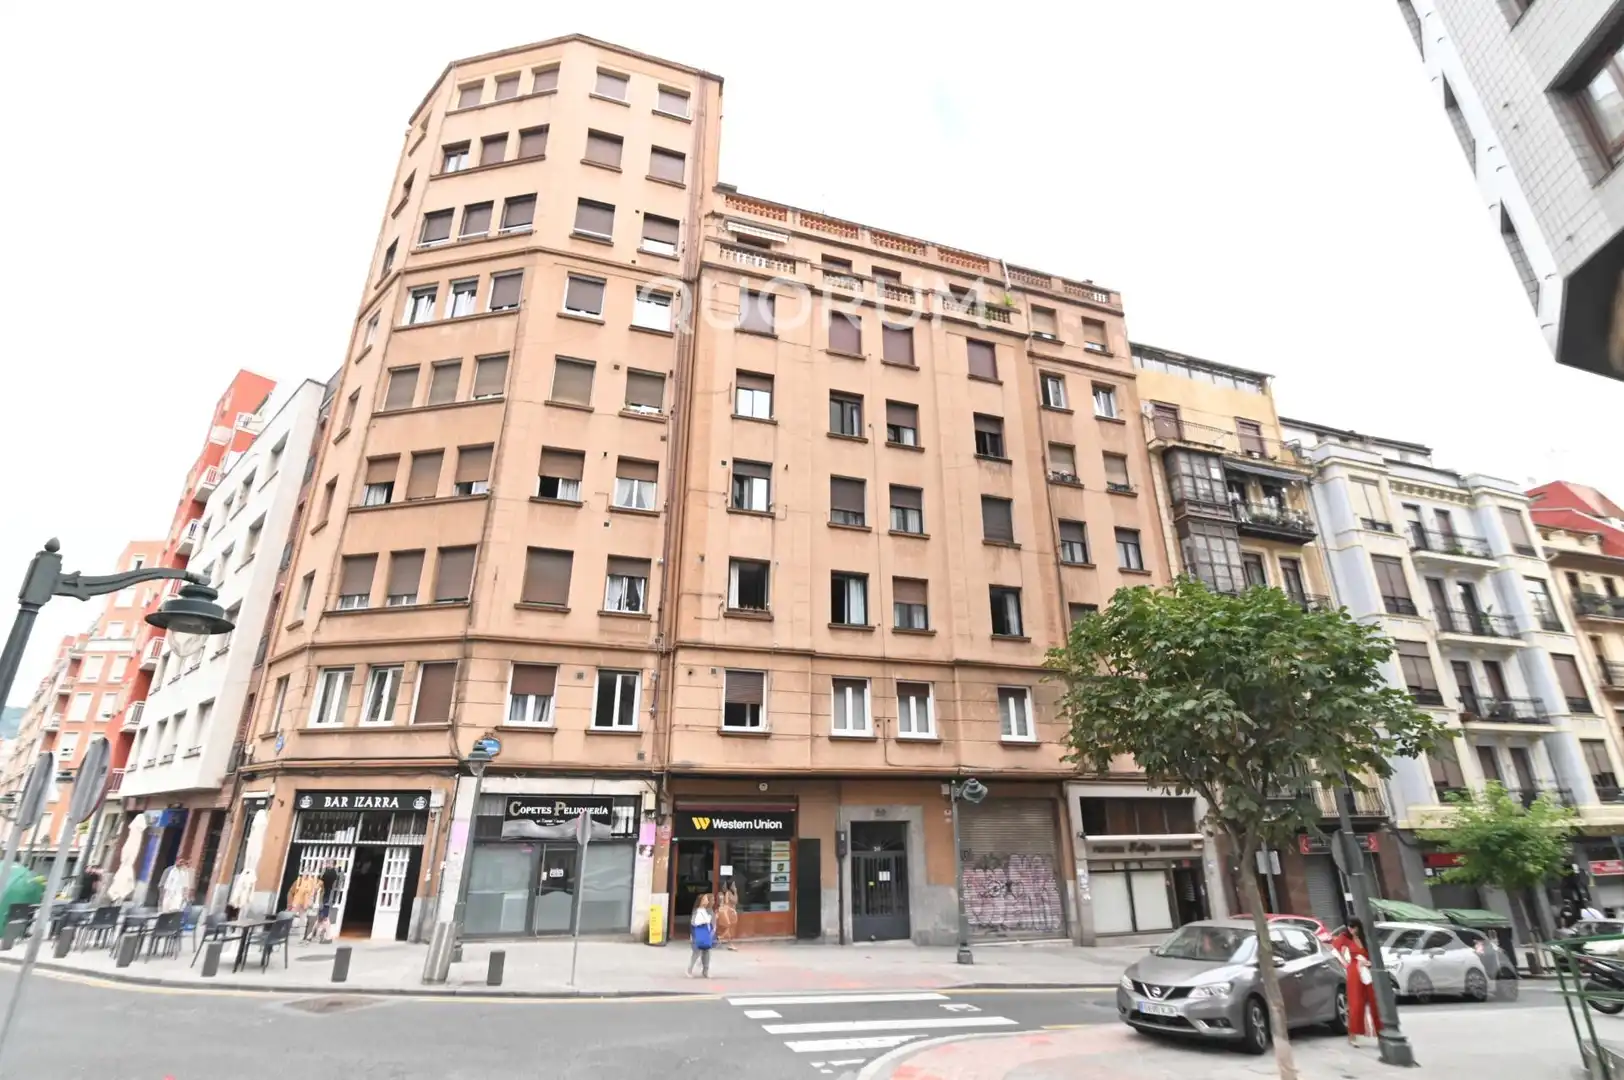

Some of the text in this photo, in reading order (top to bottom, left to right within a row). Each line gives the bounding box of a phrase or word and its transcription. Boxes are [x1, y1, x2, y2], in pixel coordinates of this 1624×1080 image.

[324, 796, 348, 808] BAR
[354, 796, 400, 808] IZARRA
[509, 801, 552, 816] COPETES
[712, 818, 753, 829] Western
[753, 818, 783, 829] Union
